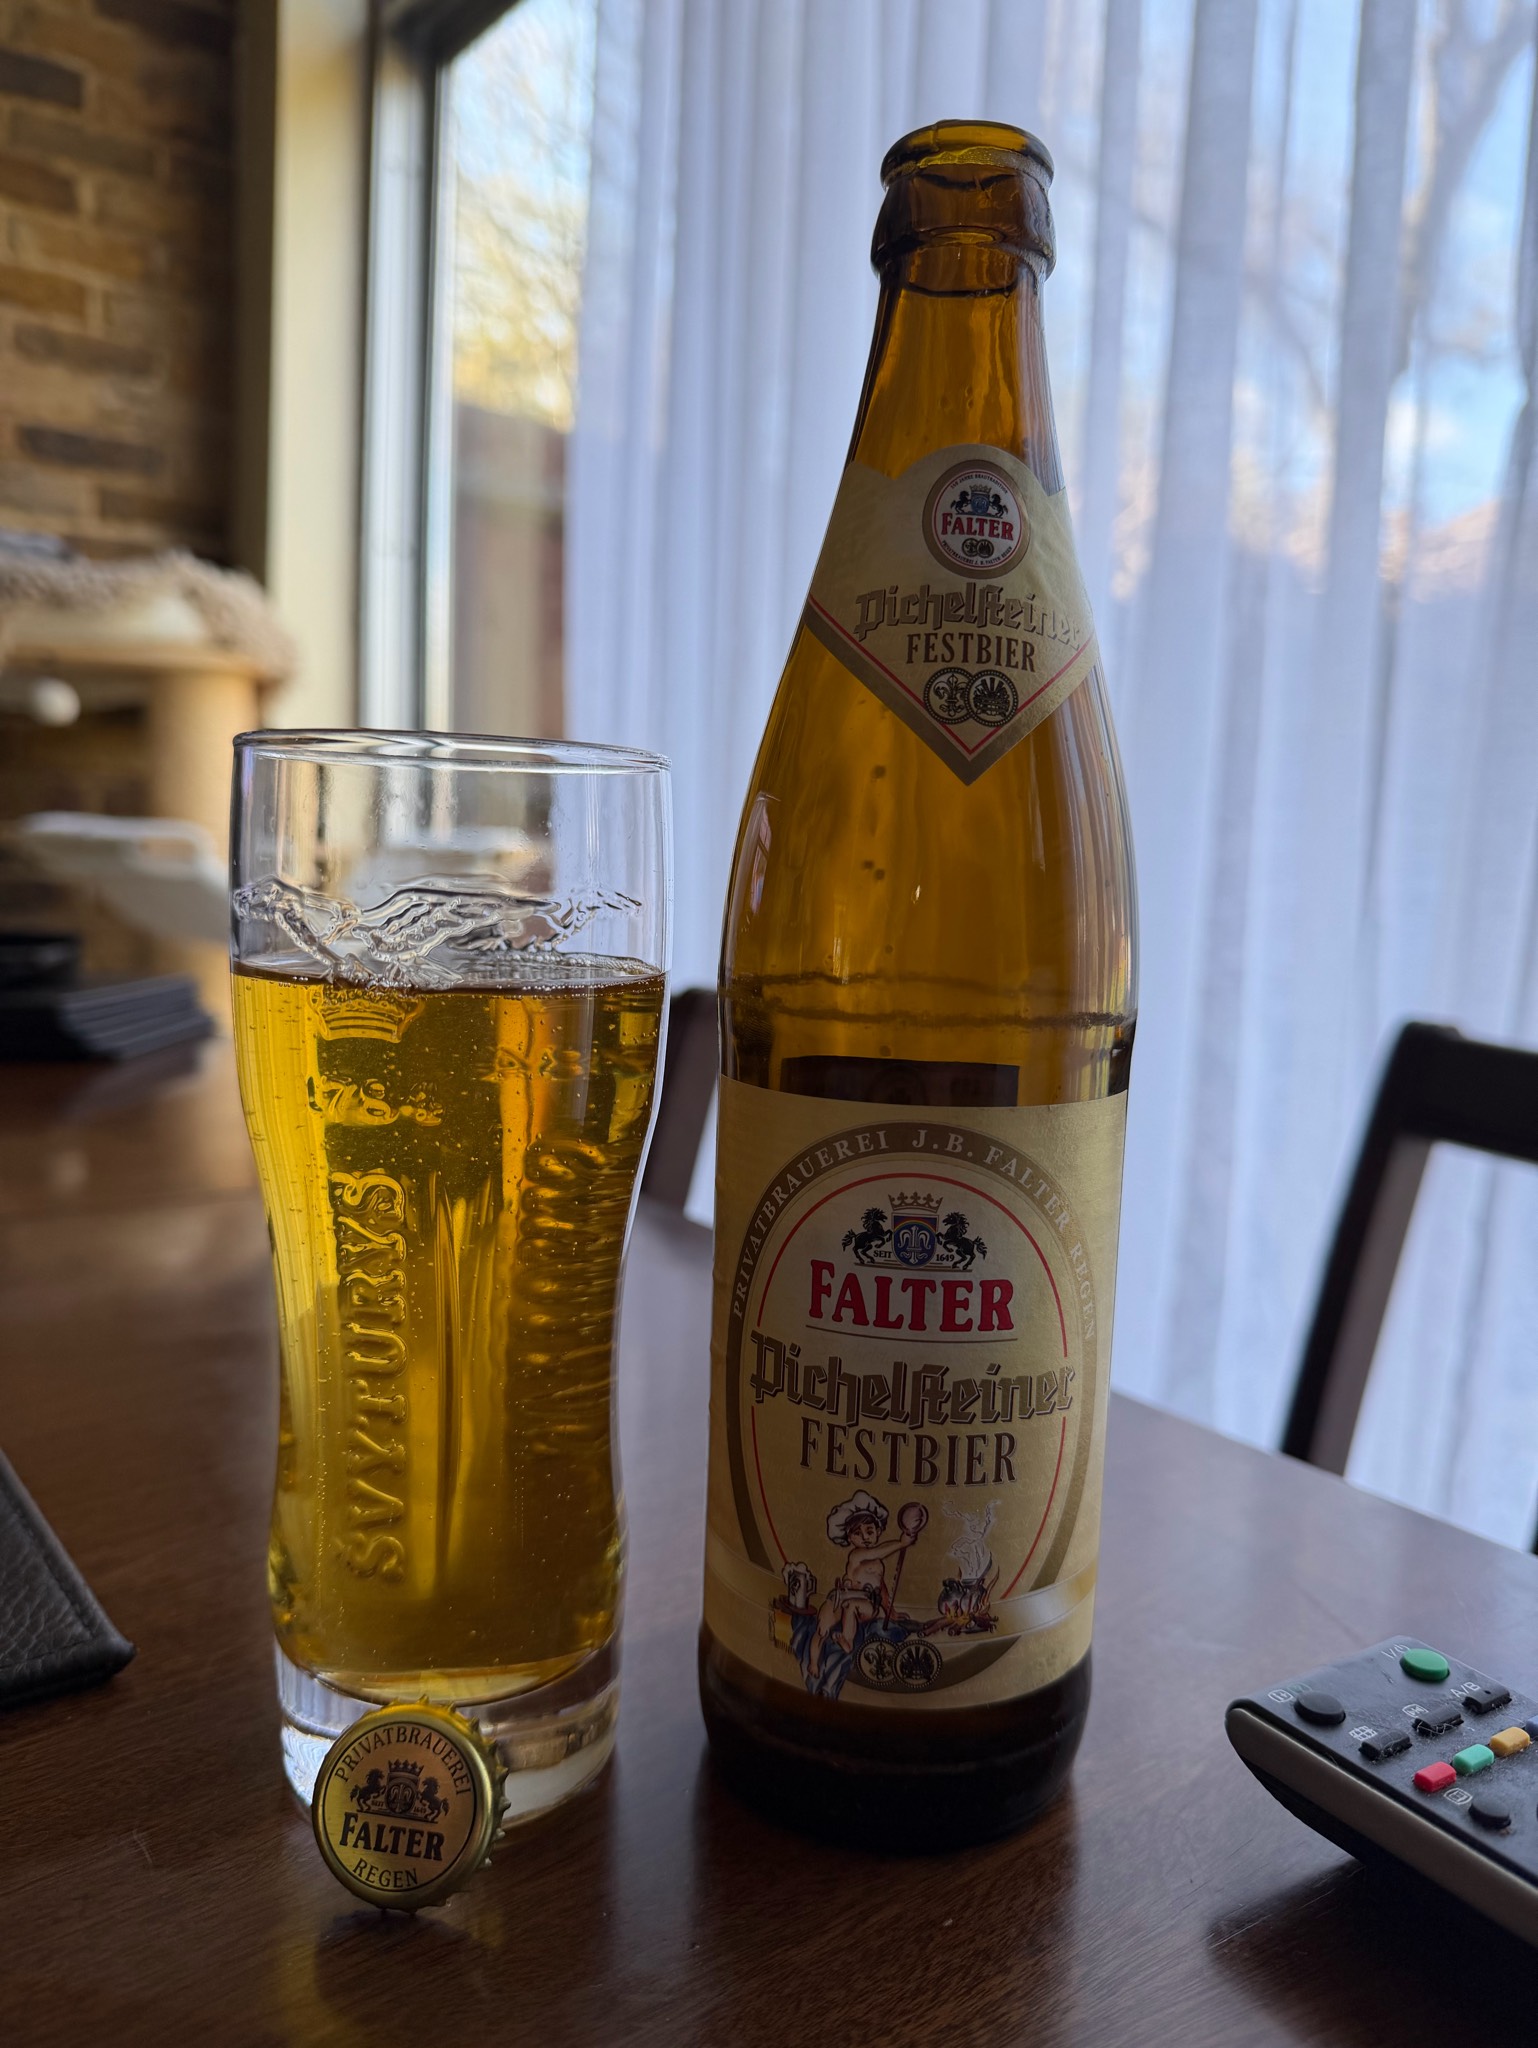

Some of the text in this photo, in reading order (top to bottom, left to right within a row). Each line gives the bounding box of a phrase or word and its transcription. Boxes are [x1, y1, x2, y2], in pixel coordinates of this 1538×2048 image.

[941, 512, 1014, 541] FALTER
[906, 632, 1036, 673] FESTBIER
[732, 1129, 890, 1321] PRIVATBRAUEREI
[984, 1145, 1072, 1234] FALTER
[1070, 1241, 1098, 1340] REGEN
[873, 1249, 955, 1263] SEIT 1649
[808, 1258, 1015, 1332] FALTER
[800, 1414, 1017, 1487] FESTBIER
[334, 1725, 473, 1796] PRIVATBRAUEREI
[339, 1811, 445, 1862] FALTER
[352, 1857, 419, 1888] REGEN
